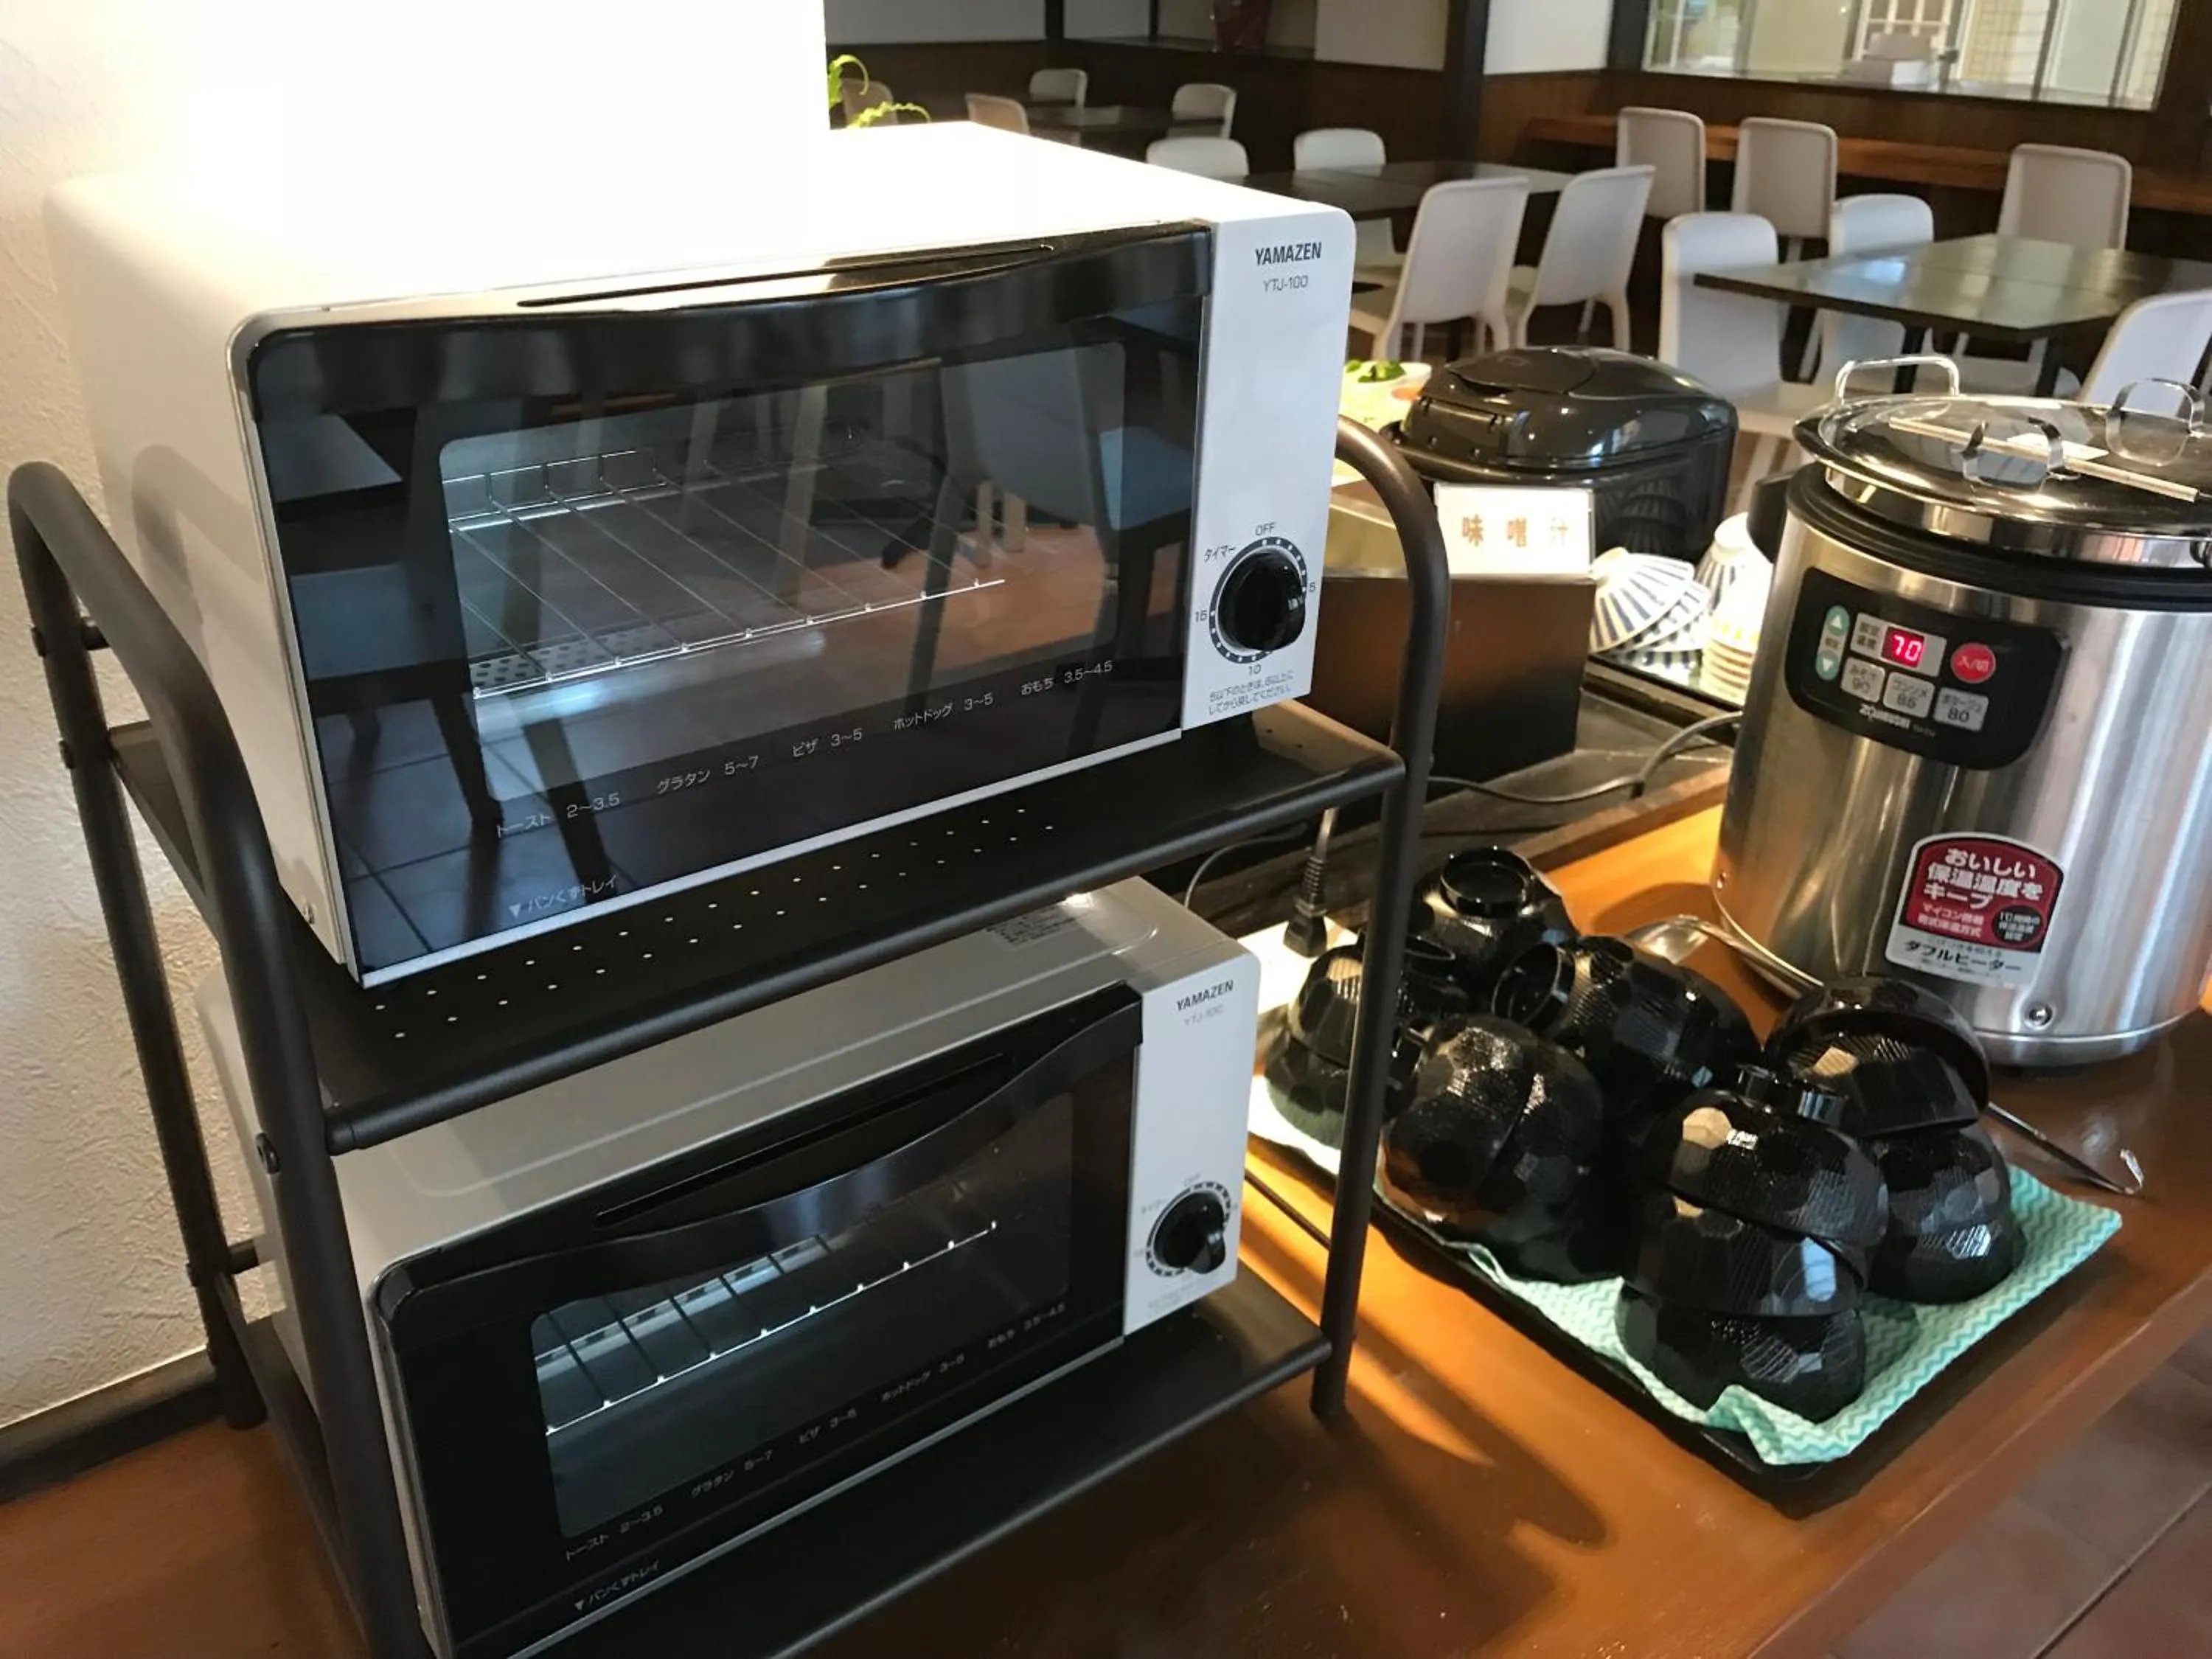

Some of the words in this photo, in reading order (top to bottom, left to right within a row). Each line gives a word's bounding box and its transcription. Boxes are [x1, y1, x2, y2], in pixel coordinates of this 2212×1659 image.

[1256, 242, 1322, 266] YAMAZEN
[1264, 275, 1309, 292] YTJ-100
[1256, 522, 1276, 536] OFF
[1204, 545, 1236, 563] タイマー
[1893, 633, 1924, 662] 70
[1248, 664, 1262, 676] 10
[1947, 708, 1970, 723] 80
[495, 812, 554, 839] トースト
[655, 769, 712, 796] グラタン
[893, 703, 954, 731] ホットドッグ
[1020, 677, 1054, 696] おもち
[1944, 848, 2037, 878] おいしい
[1927, 862, 2043, 901] 保温温度を
[1924, 882, 1994, 909] キープ
[1176, 979, 1234, 1011] YAMAZEN
